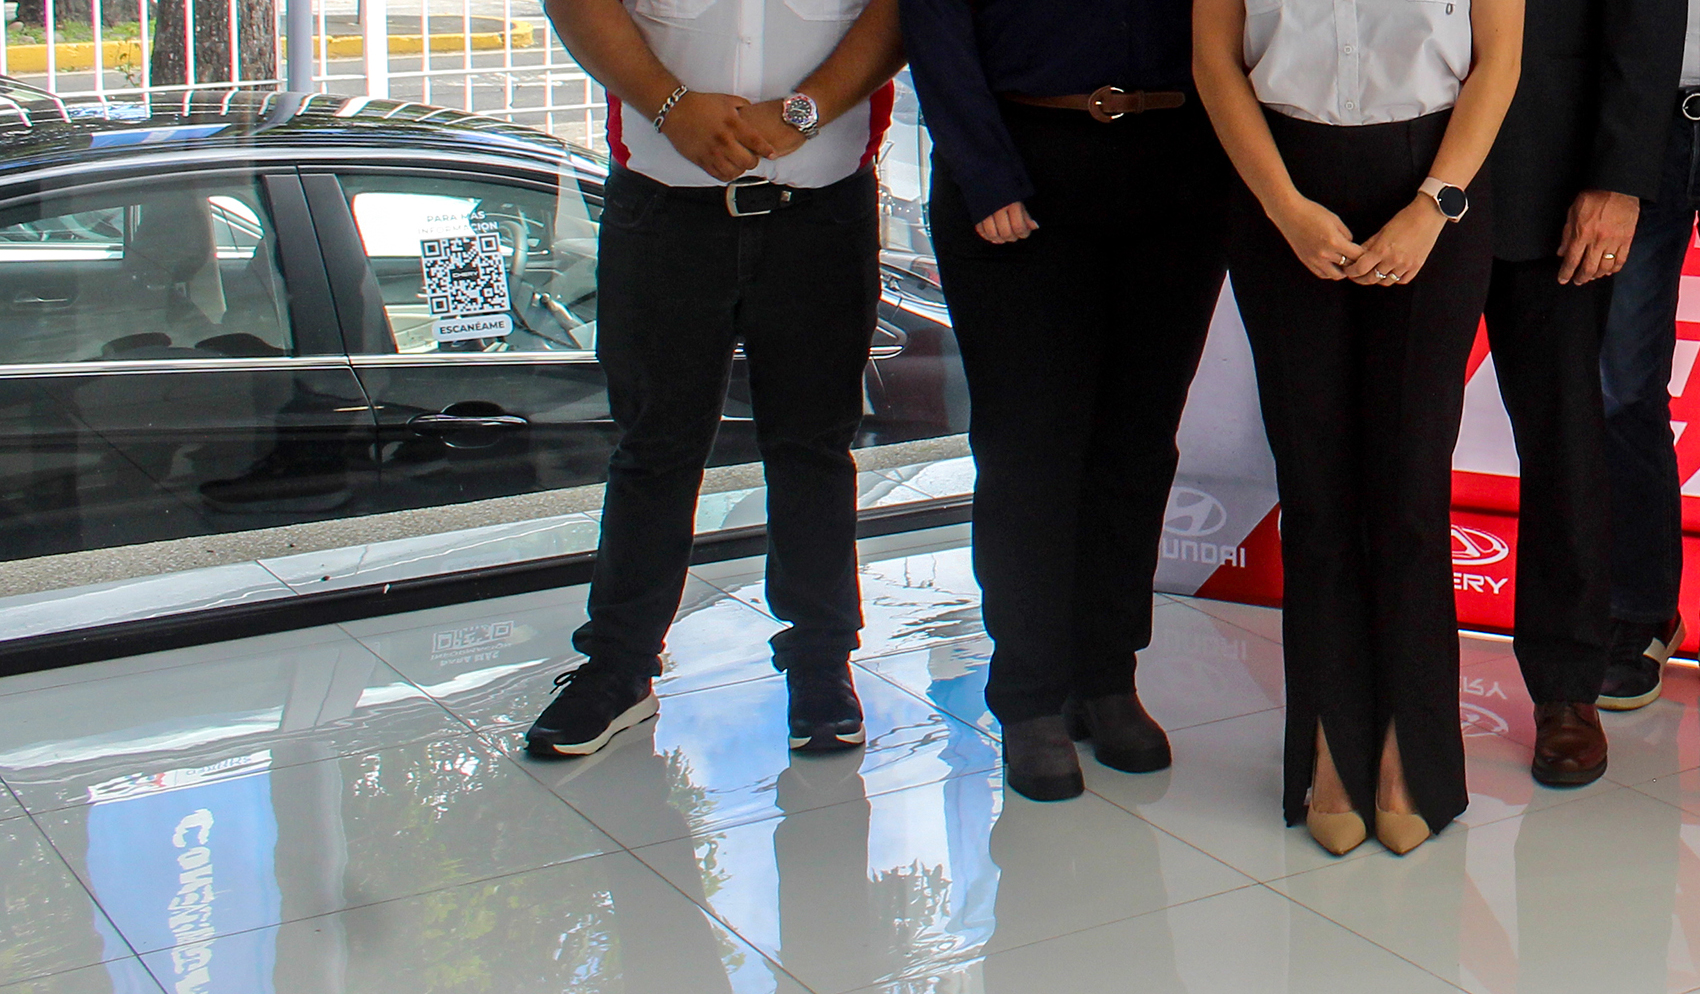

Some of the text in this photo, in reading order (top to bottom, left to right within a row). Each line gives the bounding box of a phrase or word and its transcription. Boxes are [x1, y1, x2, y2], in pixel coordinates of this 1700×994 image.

[427, 214, 457, 222] PARA
[440, 321, 505, 334] ESCANÉAME
[1162, 537, 1246, 568] UNDAI
[1453, 572, 1508, 594] ERY
